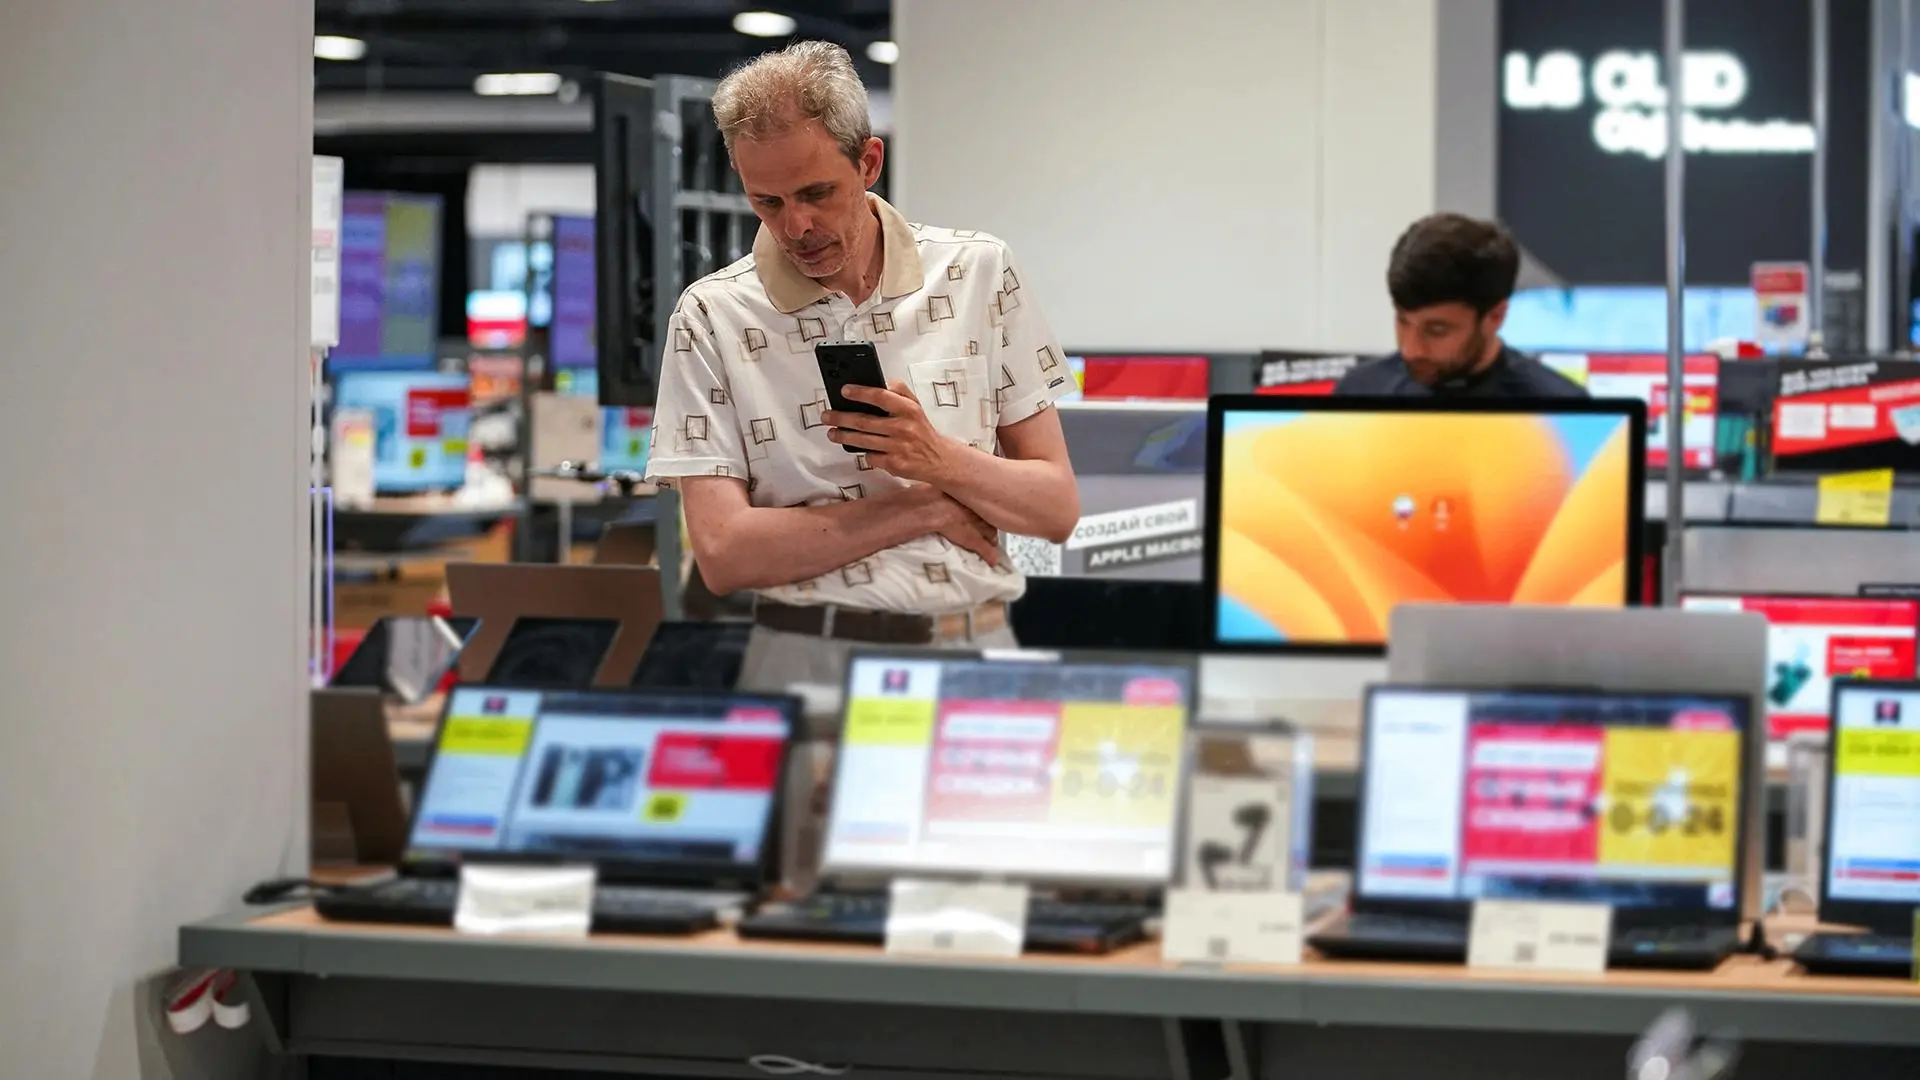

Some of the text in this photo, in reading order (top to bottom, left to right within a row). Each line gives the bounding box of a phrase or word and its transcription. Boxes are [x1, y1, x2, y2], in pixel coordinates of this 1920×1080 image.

[1075, 508, 1188, 539] СОЗДАЙ СВОЙ
[1089, 536, 1203, 567] APPLE MACBO
